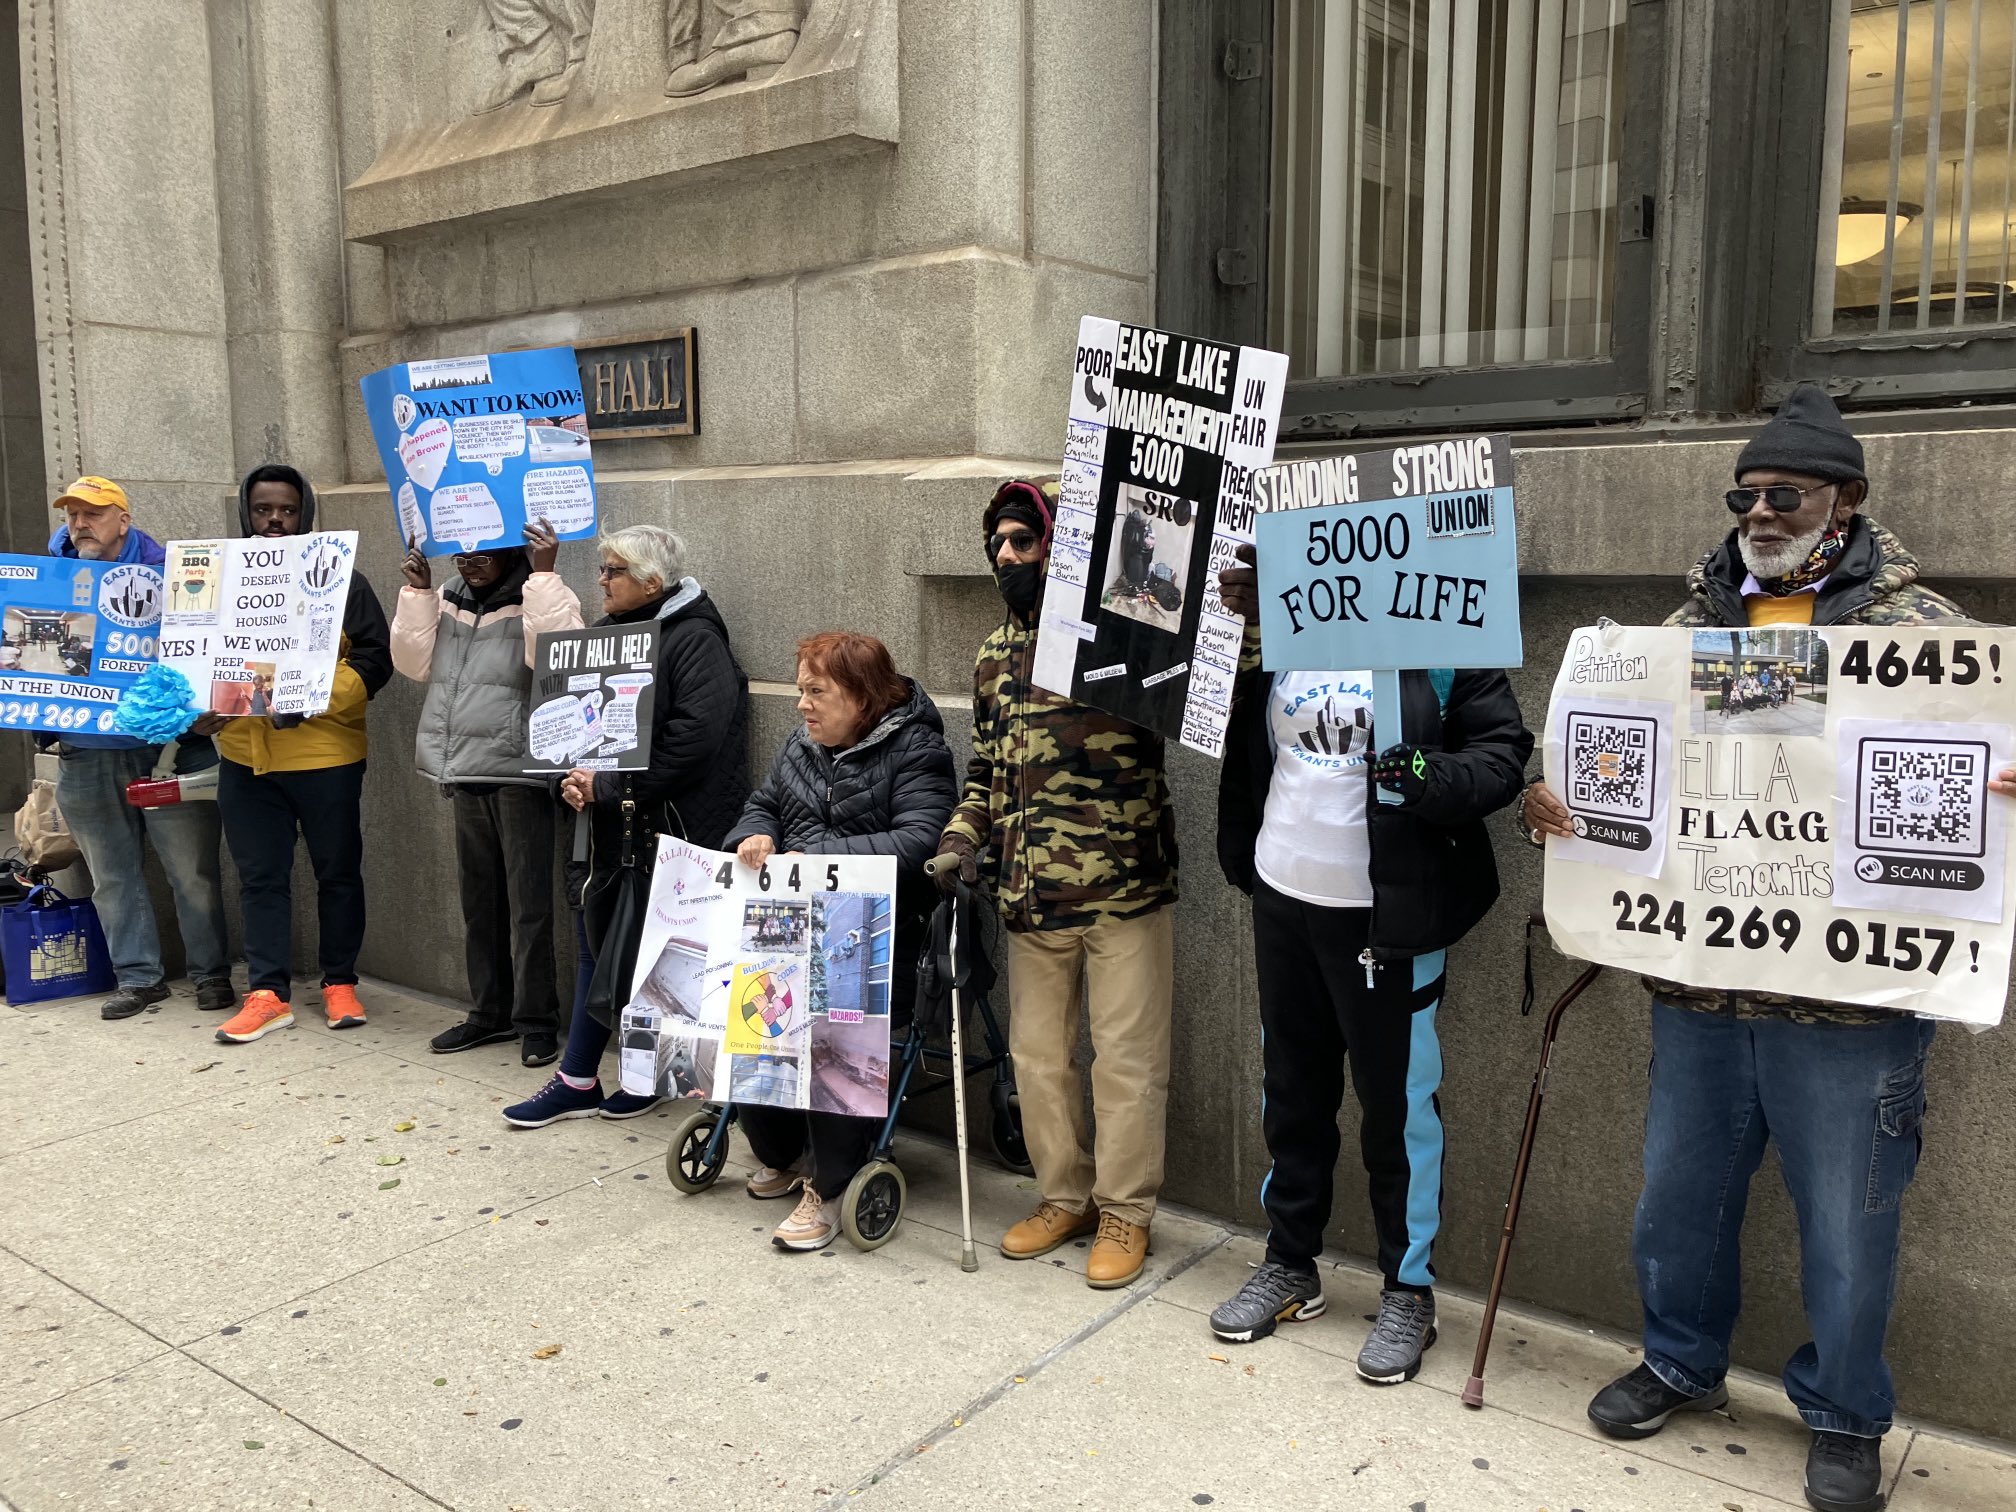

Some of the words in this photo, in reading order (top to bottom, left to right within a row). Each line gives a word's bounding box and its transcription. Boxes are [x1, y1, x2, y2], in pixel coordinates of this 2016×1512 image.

[1076, 346, 1112, 379] POOR
[1115, 326, 1169, 376] EAST
[1176, 340, 1230, 395] LAKE
[595, 356, 681, 415] HALL
[1243, 378, 1266, 410] UN
[415, 397, 478, 418] WANT
[483, 396, 511, 413] TO
[1108, 387, 1233, 456] MANAGEMENT
[1230, 413, 1266, 448] FAIR
[1067, 425, 1099, 448] Joseph
[416, 442, 445, 456] Brown
[1129, 434, 1184, 487] 5000
[526, 471, 544, 479] FIRE
[546, 468, 583, 477] HAZARDS
[1063, 470, 1083, 483] Eric
[1254, 454, 1359, 514] STANDING
[1392, 436, 1495, 497] STRONG
[1143, 490, 1192, 526] SRO
[1219, 503, 1255, 534] MENT
[1431, 493, 1489, 533] UNION
[301, 536, 324, 560] EAST
[326, 536, 352, 557] LAKE
[1307, 512, 1410, 566] 5000
[182, 557, 210, 567] BBQ
[242, 549, 284, 568] YOU
[1050, 556, 1073, 571] Jason
[103, 567, 133, 586] EAST
[185, 569, 205, 577] Party
[241, 574, 290, 586] DESERVE
[1056, 569, 1079, 581] Burns
[323, 577, 345, 596] UNION
[236, 593, 285, 609] GOOD
[1279, 575, 1369, 635] FOR
[1387, 570, 1487, 628] LIFE
[236, 614, 287, 628] HOUSING
[106, 631, 160, 659] 500
[161, 640, 195, 658] YES
[224, 635, 250, 650] WE
[550, 639, 582, 670] CITY
[586, 637, 616, 668] HALL
[621, 633, 651, 664] HELP
[214, 657, 244, 667] PEEP
[1195, 647, 1231, 675] Plumbing
[1569, 635, 1647, 683] Petition
[213, 670, 253, 681] HOLES
[280, 670, 302, 681] OVER
[539, 674, 564, 697] WITH
[19, 681, 53, 694] THE
[60, 683, 115, 700] UNION
[278, 685, 304, 696] NIGHT
[309, 689, 329, 702] More
[1283, 684, 1330, 717] EAST
[1338, 682, 1373, 700] LAK
[275, 699, 304, 711] GUESTS
[43, 704, 91, 729] 269
[1182, 727, 1221, 753] GUEST
[1290, 742, 1340, 768] TENANTS
[1679, 739, 1799, 803] ELLA
[1591, 825, 1619, 840] SCAN
[1622, 830, 1639, 843] ME
[1677, 806, 1831, 843] FLAGG
[658, 847, 682, 865] ELLA
[715, 861, 733, 889] 4
[759, 862, 771, 892] 6
[788, 863, 801, 892] 4
[825, 863, 838, 892] 5
[1677, 842, 1835, 898] Tenants
[1889, 864, 1939, 881] SCAN
[1941, 868, 1966, 884] ME
[1612, 890, 1687, 942] 224
[1705, 906, 1801, 953] 269
[1825, 918, 1955, 976] 0157
[692, 970, 705, 980] LEAD
[742, 956, 777, 975] BUILDING
[777, 963, 798, 982] CODES
